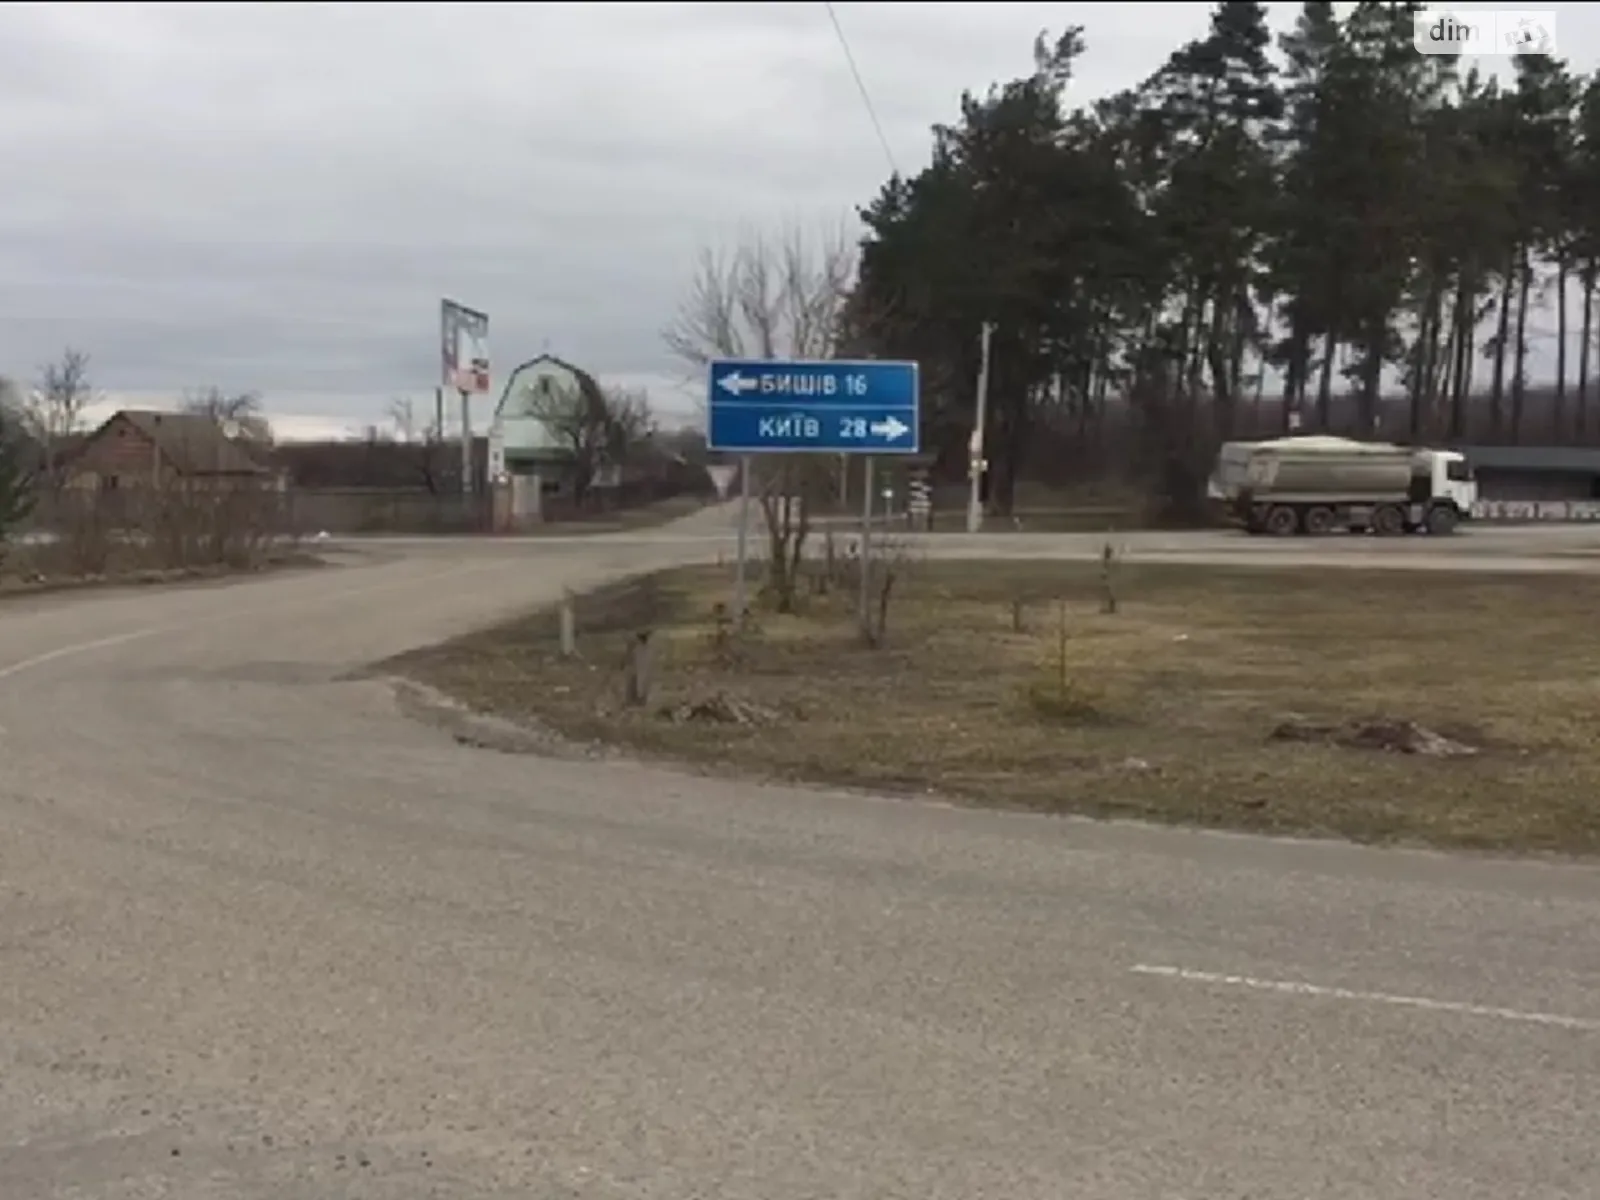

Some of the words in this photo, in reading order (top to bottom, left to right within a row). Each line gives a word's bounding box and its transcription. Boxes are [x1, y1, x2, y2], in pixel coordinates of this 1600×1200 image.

[761, 374, 837, 396] БИШІВ
[845, 374, 868, 396] 16
[759, 412, 820, 438] КИЇВ
[839, 416, 867, 438] 28
